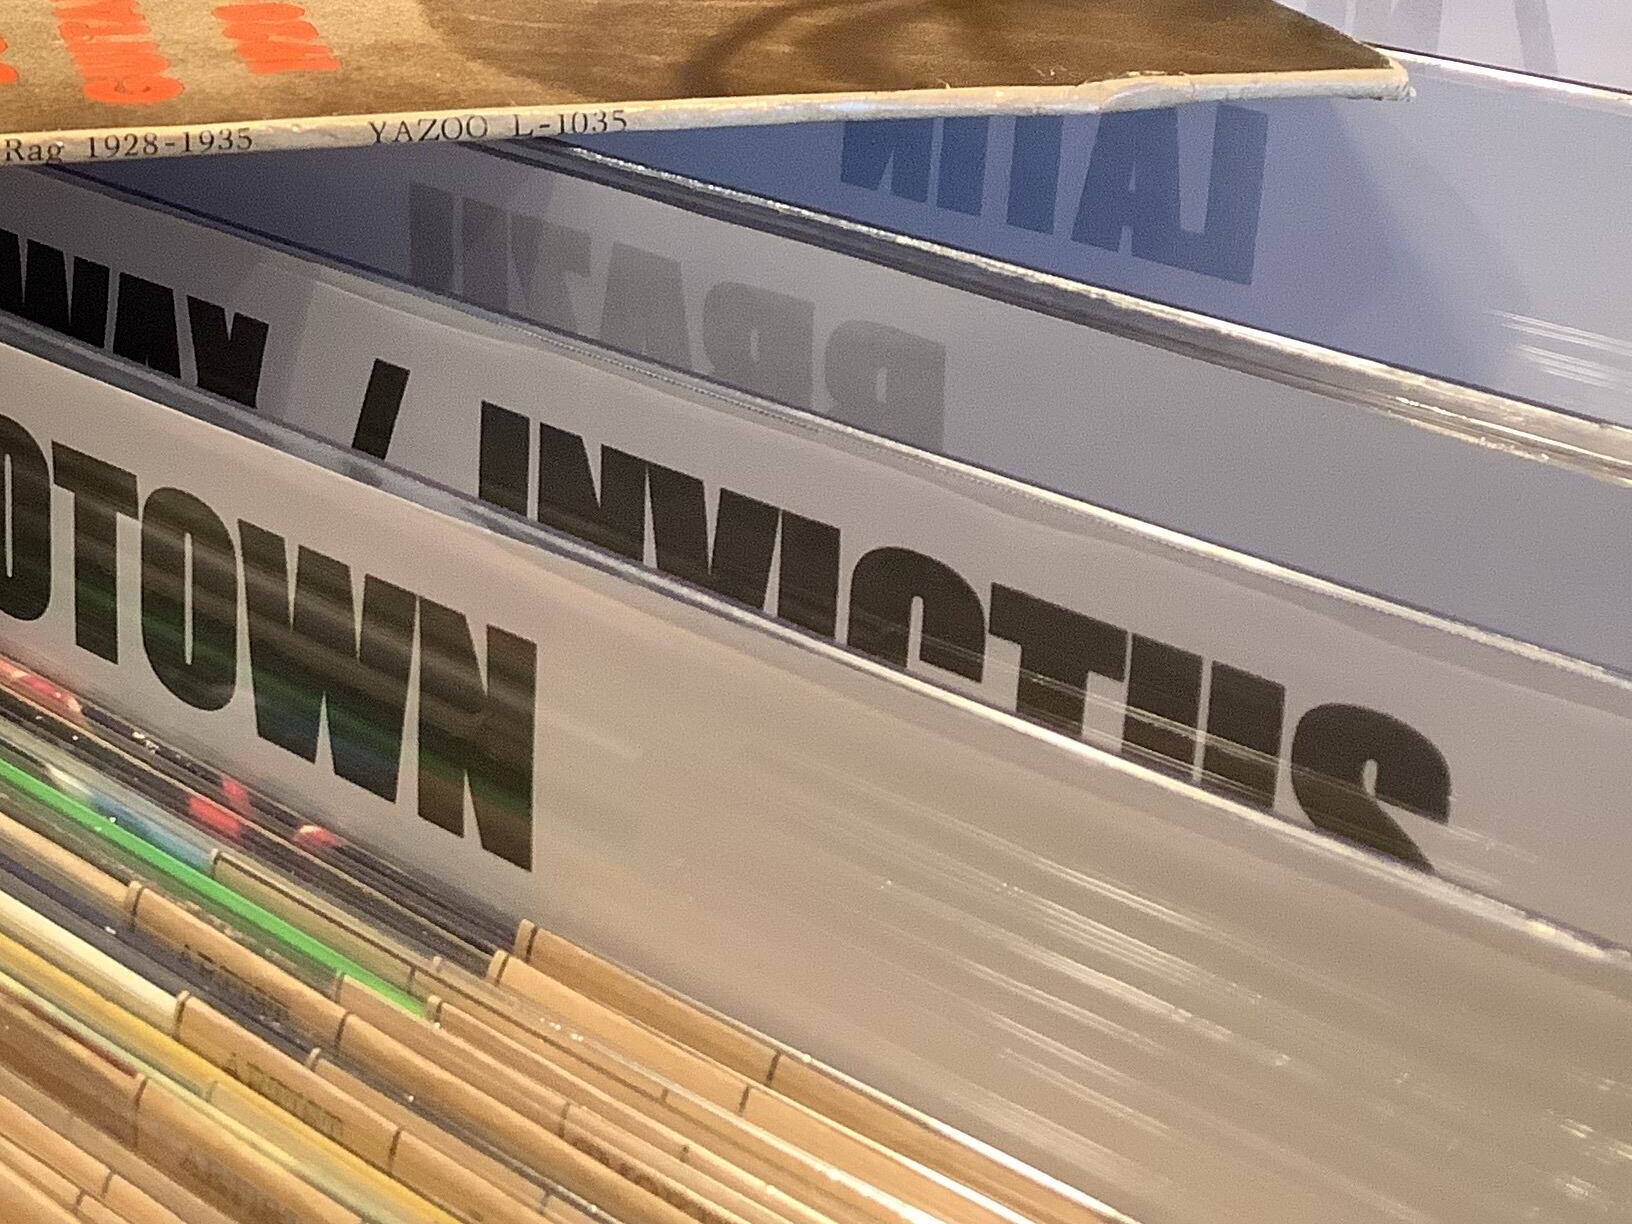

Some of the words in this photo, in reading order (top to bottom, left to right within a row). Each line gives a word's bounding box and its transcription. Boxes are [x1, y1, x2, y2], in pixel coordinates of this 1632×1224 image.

[5, 137, 65, 166] Rag
[87, 126, 255, 158] 1928-1935
[368, 113, 489, 145] YAZOO
[511, 108, 629, 138] L-1035
